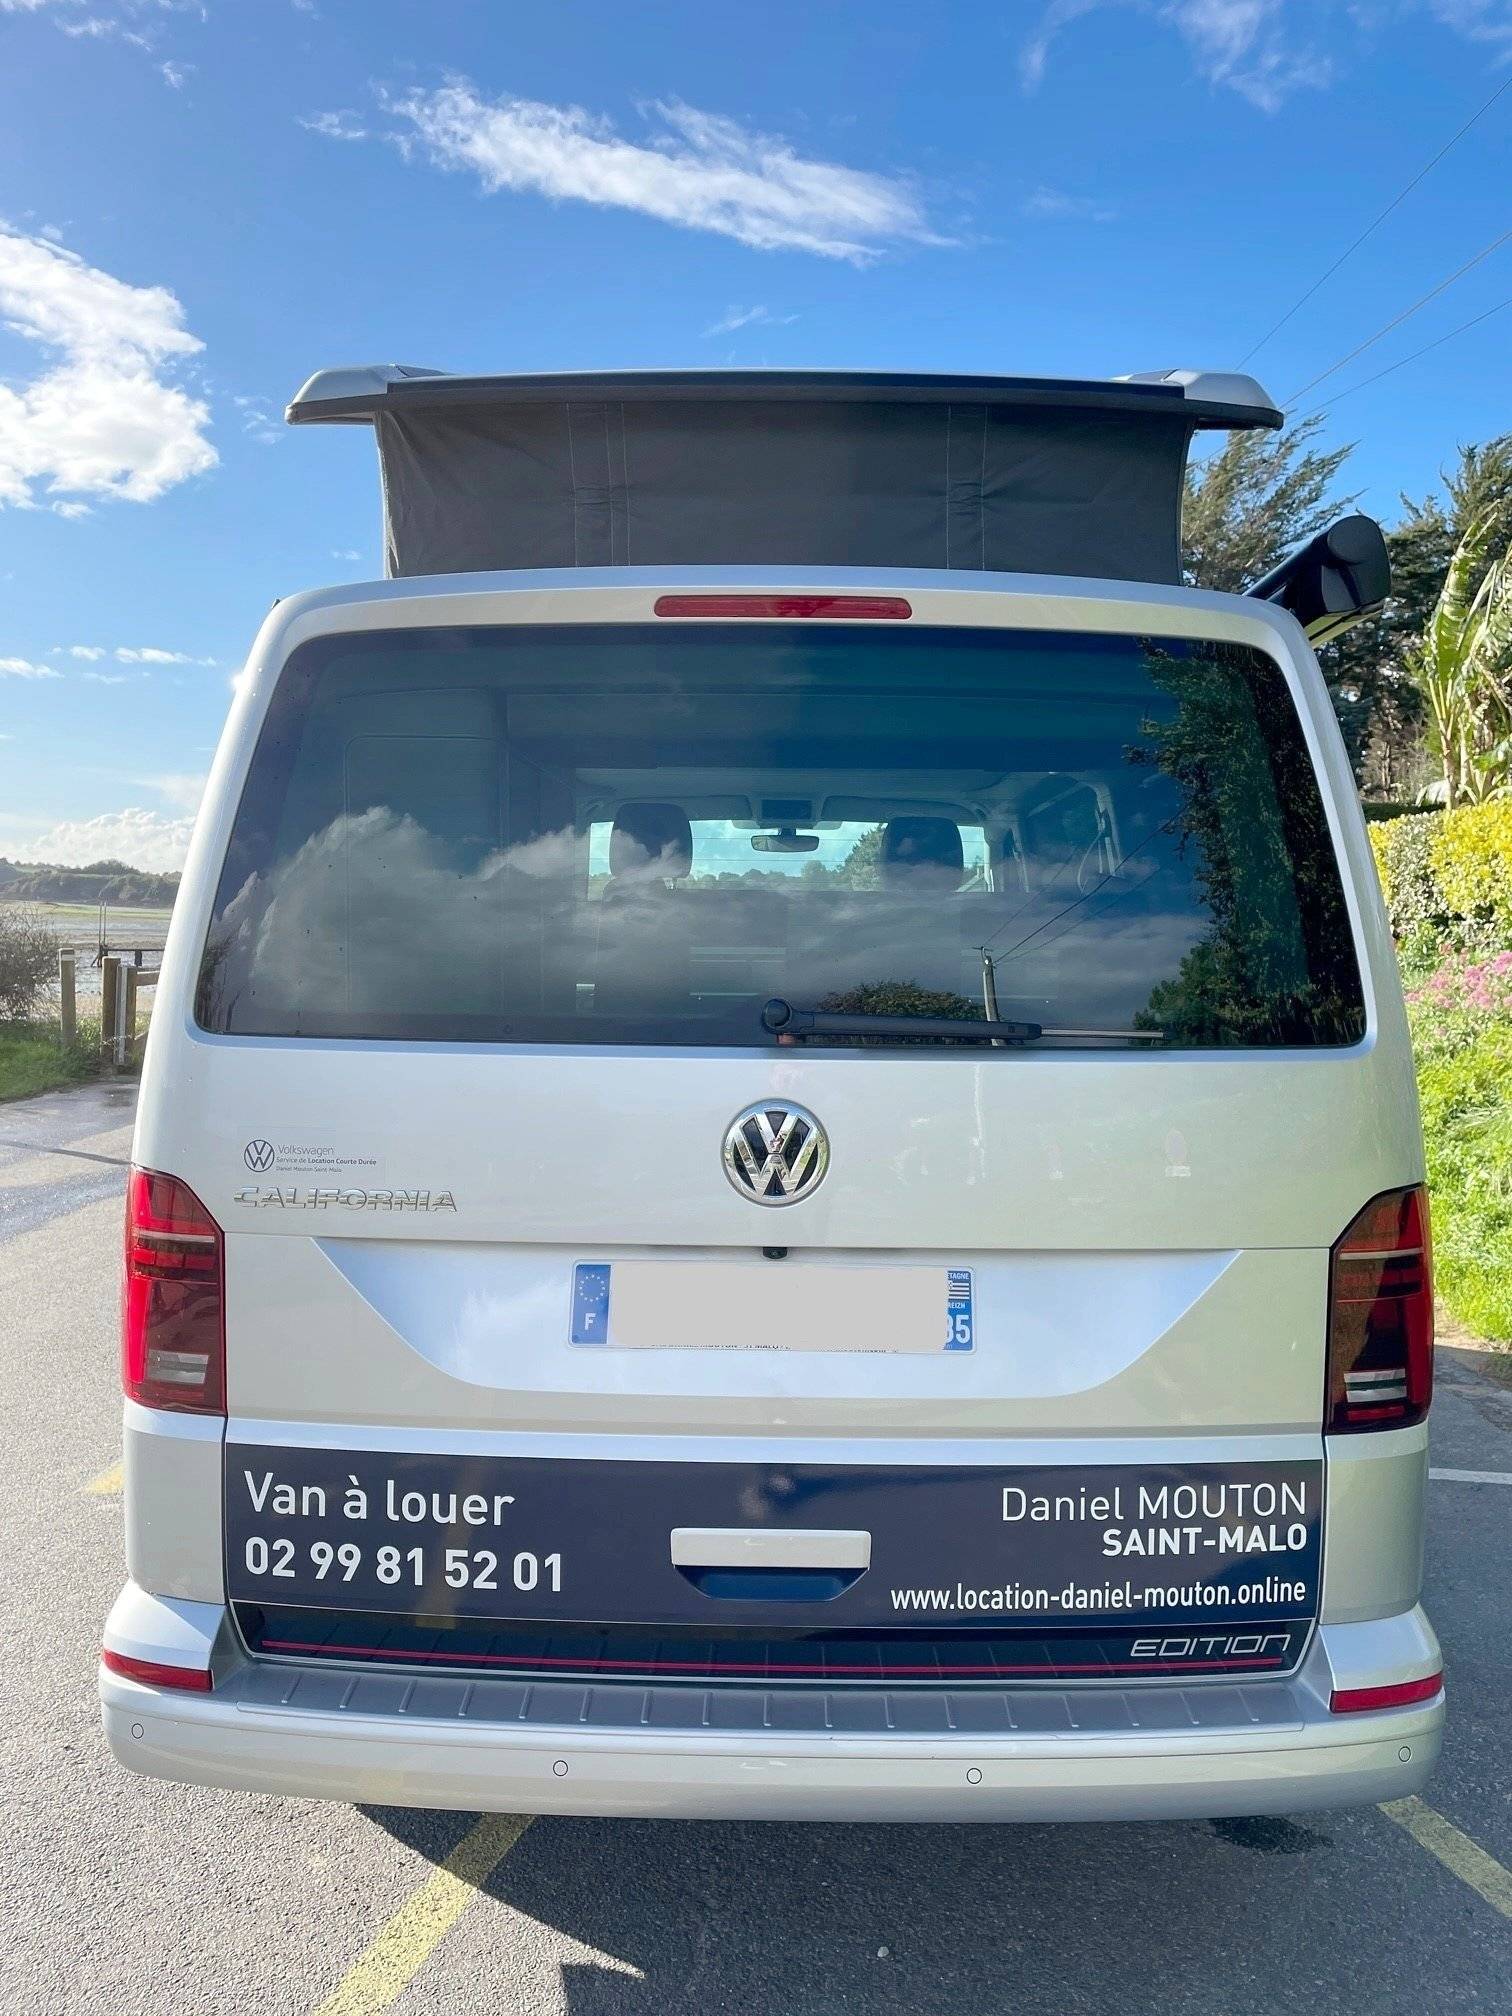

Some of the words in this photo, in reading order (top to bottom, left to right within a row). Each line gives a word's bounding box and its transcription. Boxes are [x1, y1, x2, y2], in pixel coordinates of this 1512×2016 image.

[278, 1145, 334, 1156] Volkswagen
[234, 1187, 457, 1212] CALIFORNIA
[584, 1312, 596, 1330] F
[244, 1470, 326, 1517] Van
[343, 1475, 367, 1520] à
[387, 1479, 516, 1526] louer
[1002, 1486, 1125, 1521] Daniel
[1139, 1481, 1306, 1520] MOUTON
[1101, 1523, 1307, 1557] SAINT-MALO
[245, 1536, 296, 1578] 02
[310, 1541, 362, 1582] 99
[376, 1545, 423, 1586] 81
[445, 1549, 498, 1590] 52
[513, 1551, 561, 1592] 01
[890, 1575, 1306, 1610] www.location-daniel-mouton.online
[1130, 1634, 1291, 1657] EDITION
